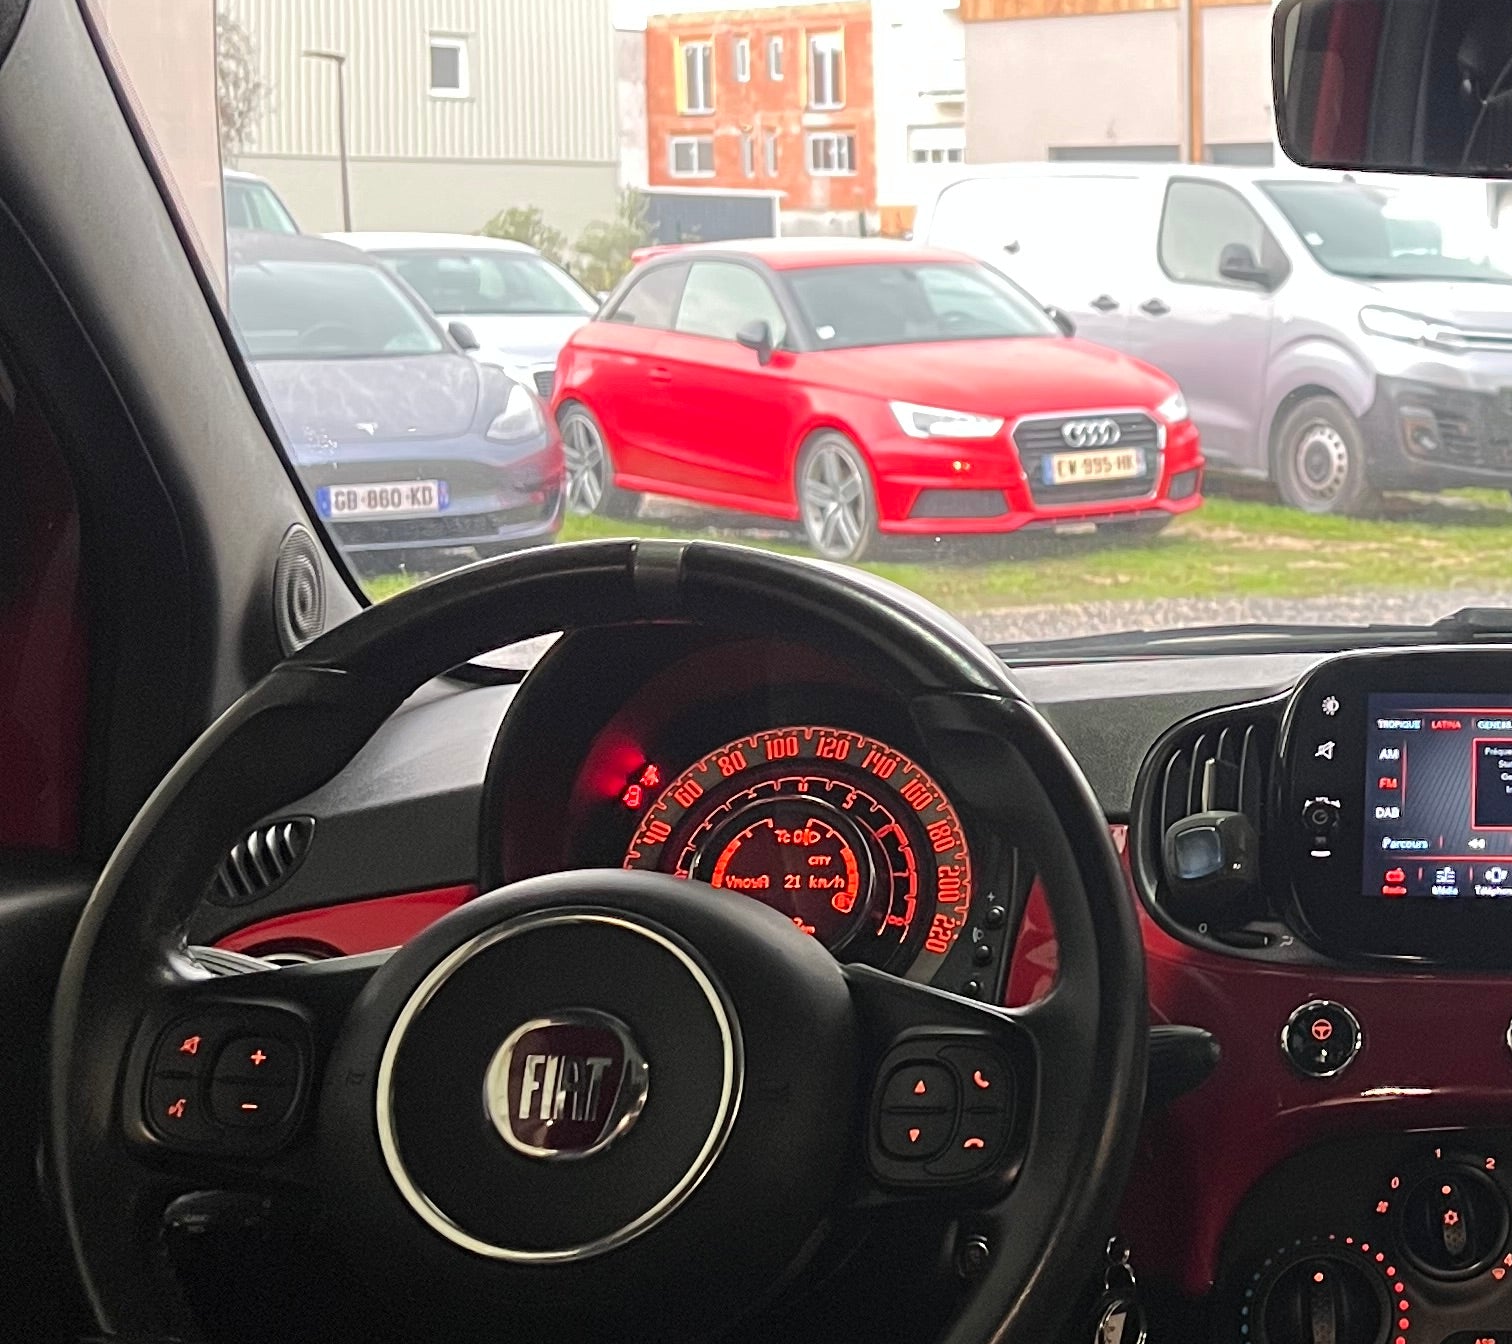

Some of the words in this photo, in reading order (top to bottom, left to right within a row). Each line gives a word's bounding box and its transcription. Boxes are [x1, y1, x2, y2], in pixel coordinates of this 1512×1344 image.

[1431, 720, 1461, 729] LATINA
[766, 736, 800, 761] 100
[816, 737, 851, 762] 120
[716, 749, 748, 778] 80
[861, 747, 899, 780] 140
[673, 779, 704, 808] 60
[899, 778, 935, 812] 160
[1379, 777, 1398, 789] FM
[1375, 807, 1400, 819] DAB
[641, 820, 672, 846] 40
[926, 821, 956, 854] 180
[1381, 836, 1429, 850] Parcours
[808, 855, 832, 866] CITY
[784, 874, 802, 889] 21
[808, 874, 846, 889] km/h
[937, 866, 961, 904] 200
[925, 912, 958, 954] 220
[518, 1054, 614, 1122] FIAT
[1485, 1156, 1497, 1171] 2
